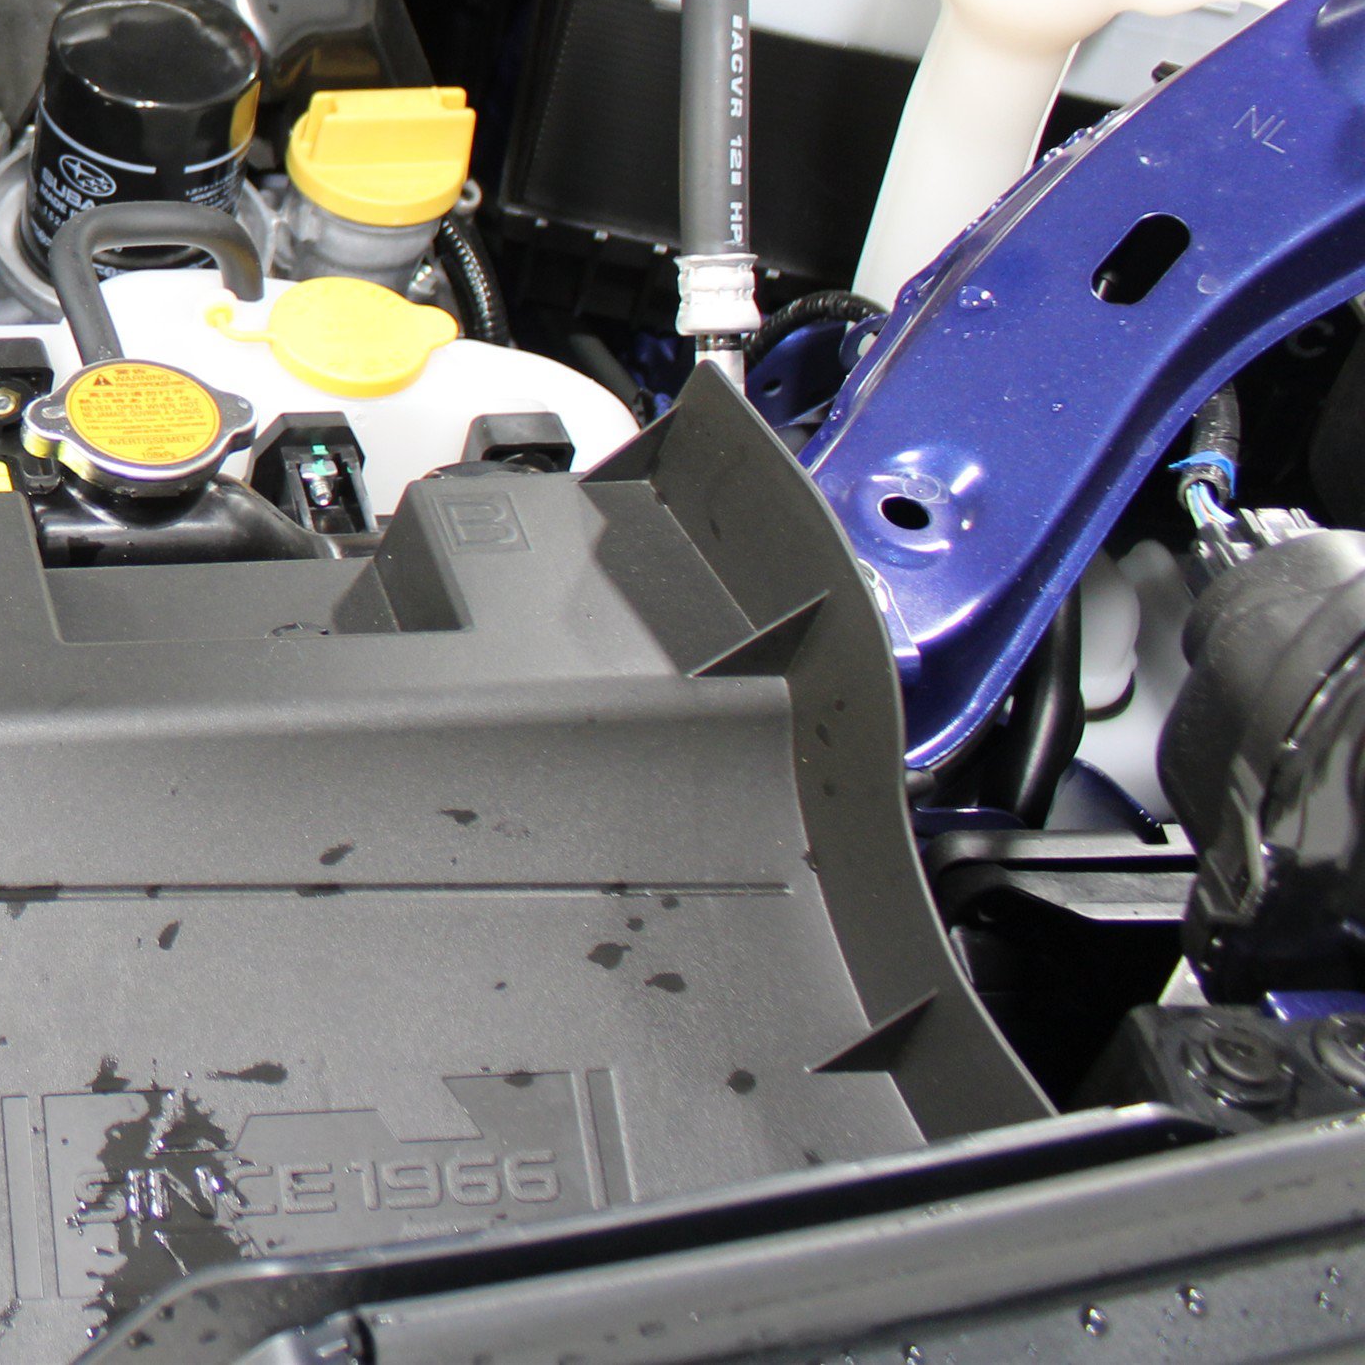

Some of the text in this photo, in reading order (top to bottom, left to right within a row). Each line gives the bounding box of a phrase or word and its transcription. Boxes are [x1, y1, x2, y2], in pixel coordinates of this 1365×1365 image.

[729, 28, 745, 118] ACVR
[41, 167, 96, 211] SUBA
[114, 374, 171, 382] WARNING
[80, 401, 199, 412] NEVER OPEN WHEN HOT
[108, 435, 198, 445] AVERTISSEMENT
